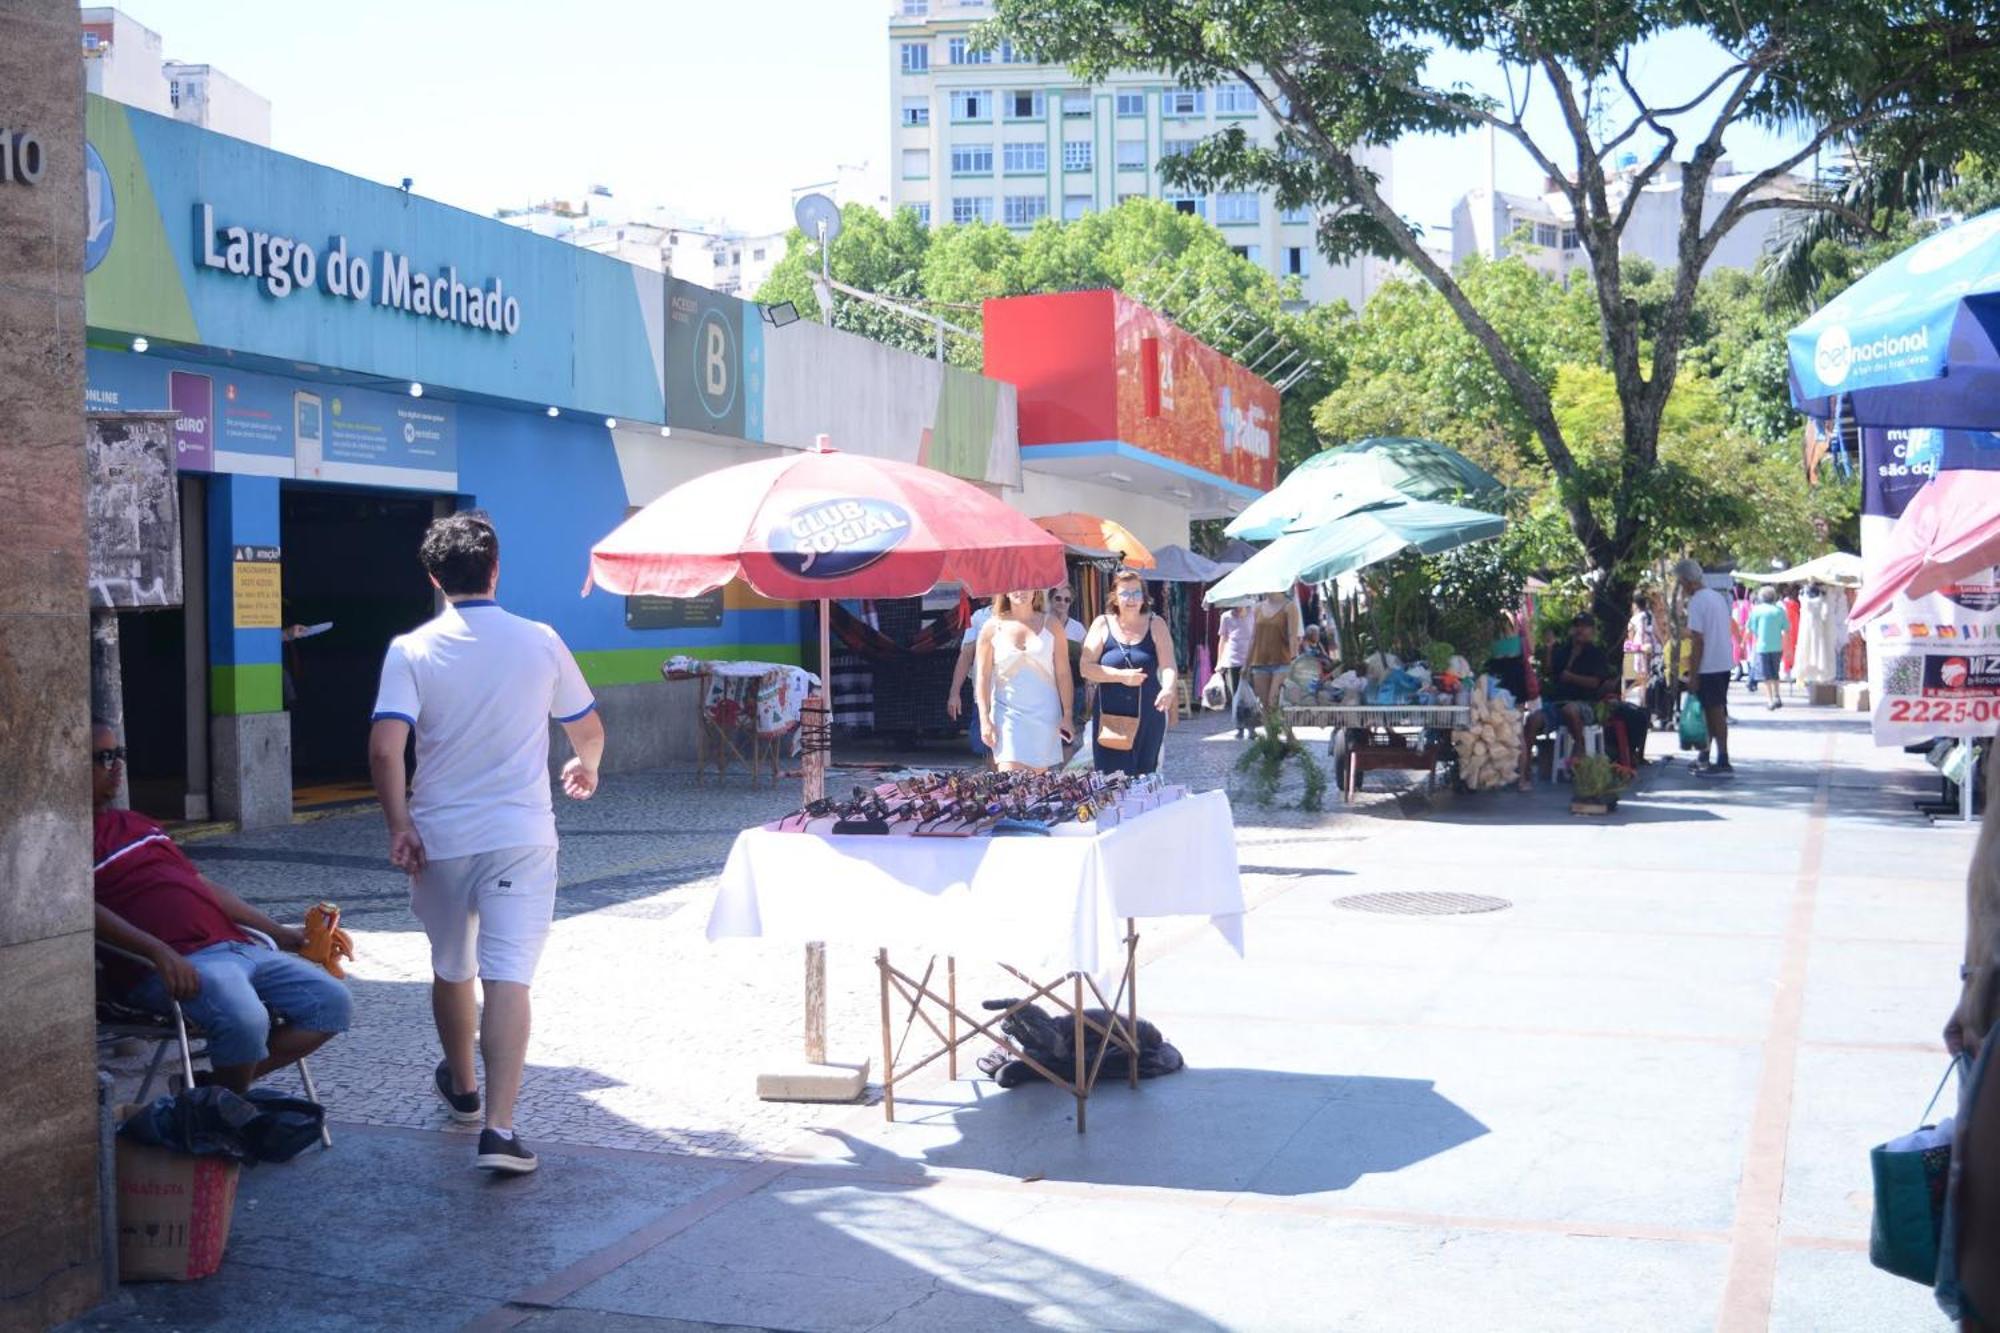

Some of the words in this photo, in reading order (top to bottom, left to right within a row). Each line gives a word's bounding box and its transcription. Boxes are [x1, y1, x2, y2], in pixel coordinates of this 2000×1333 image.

[200, 202, 316, 298] Largo
[322, 234, 370, 300] do
[379, 250, 520, 336] Machado
[706, 322, 727, 396] B
[791, 500, 866, 539] CLUB
[795, 511, 908, 573] SOCIAL
[1969, 655, 2000, 675] WIZ
